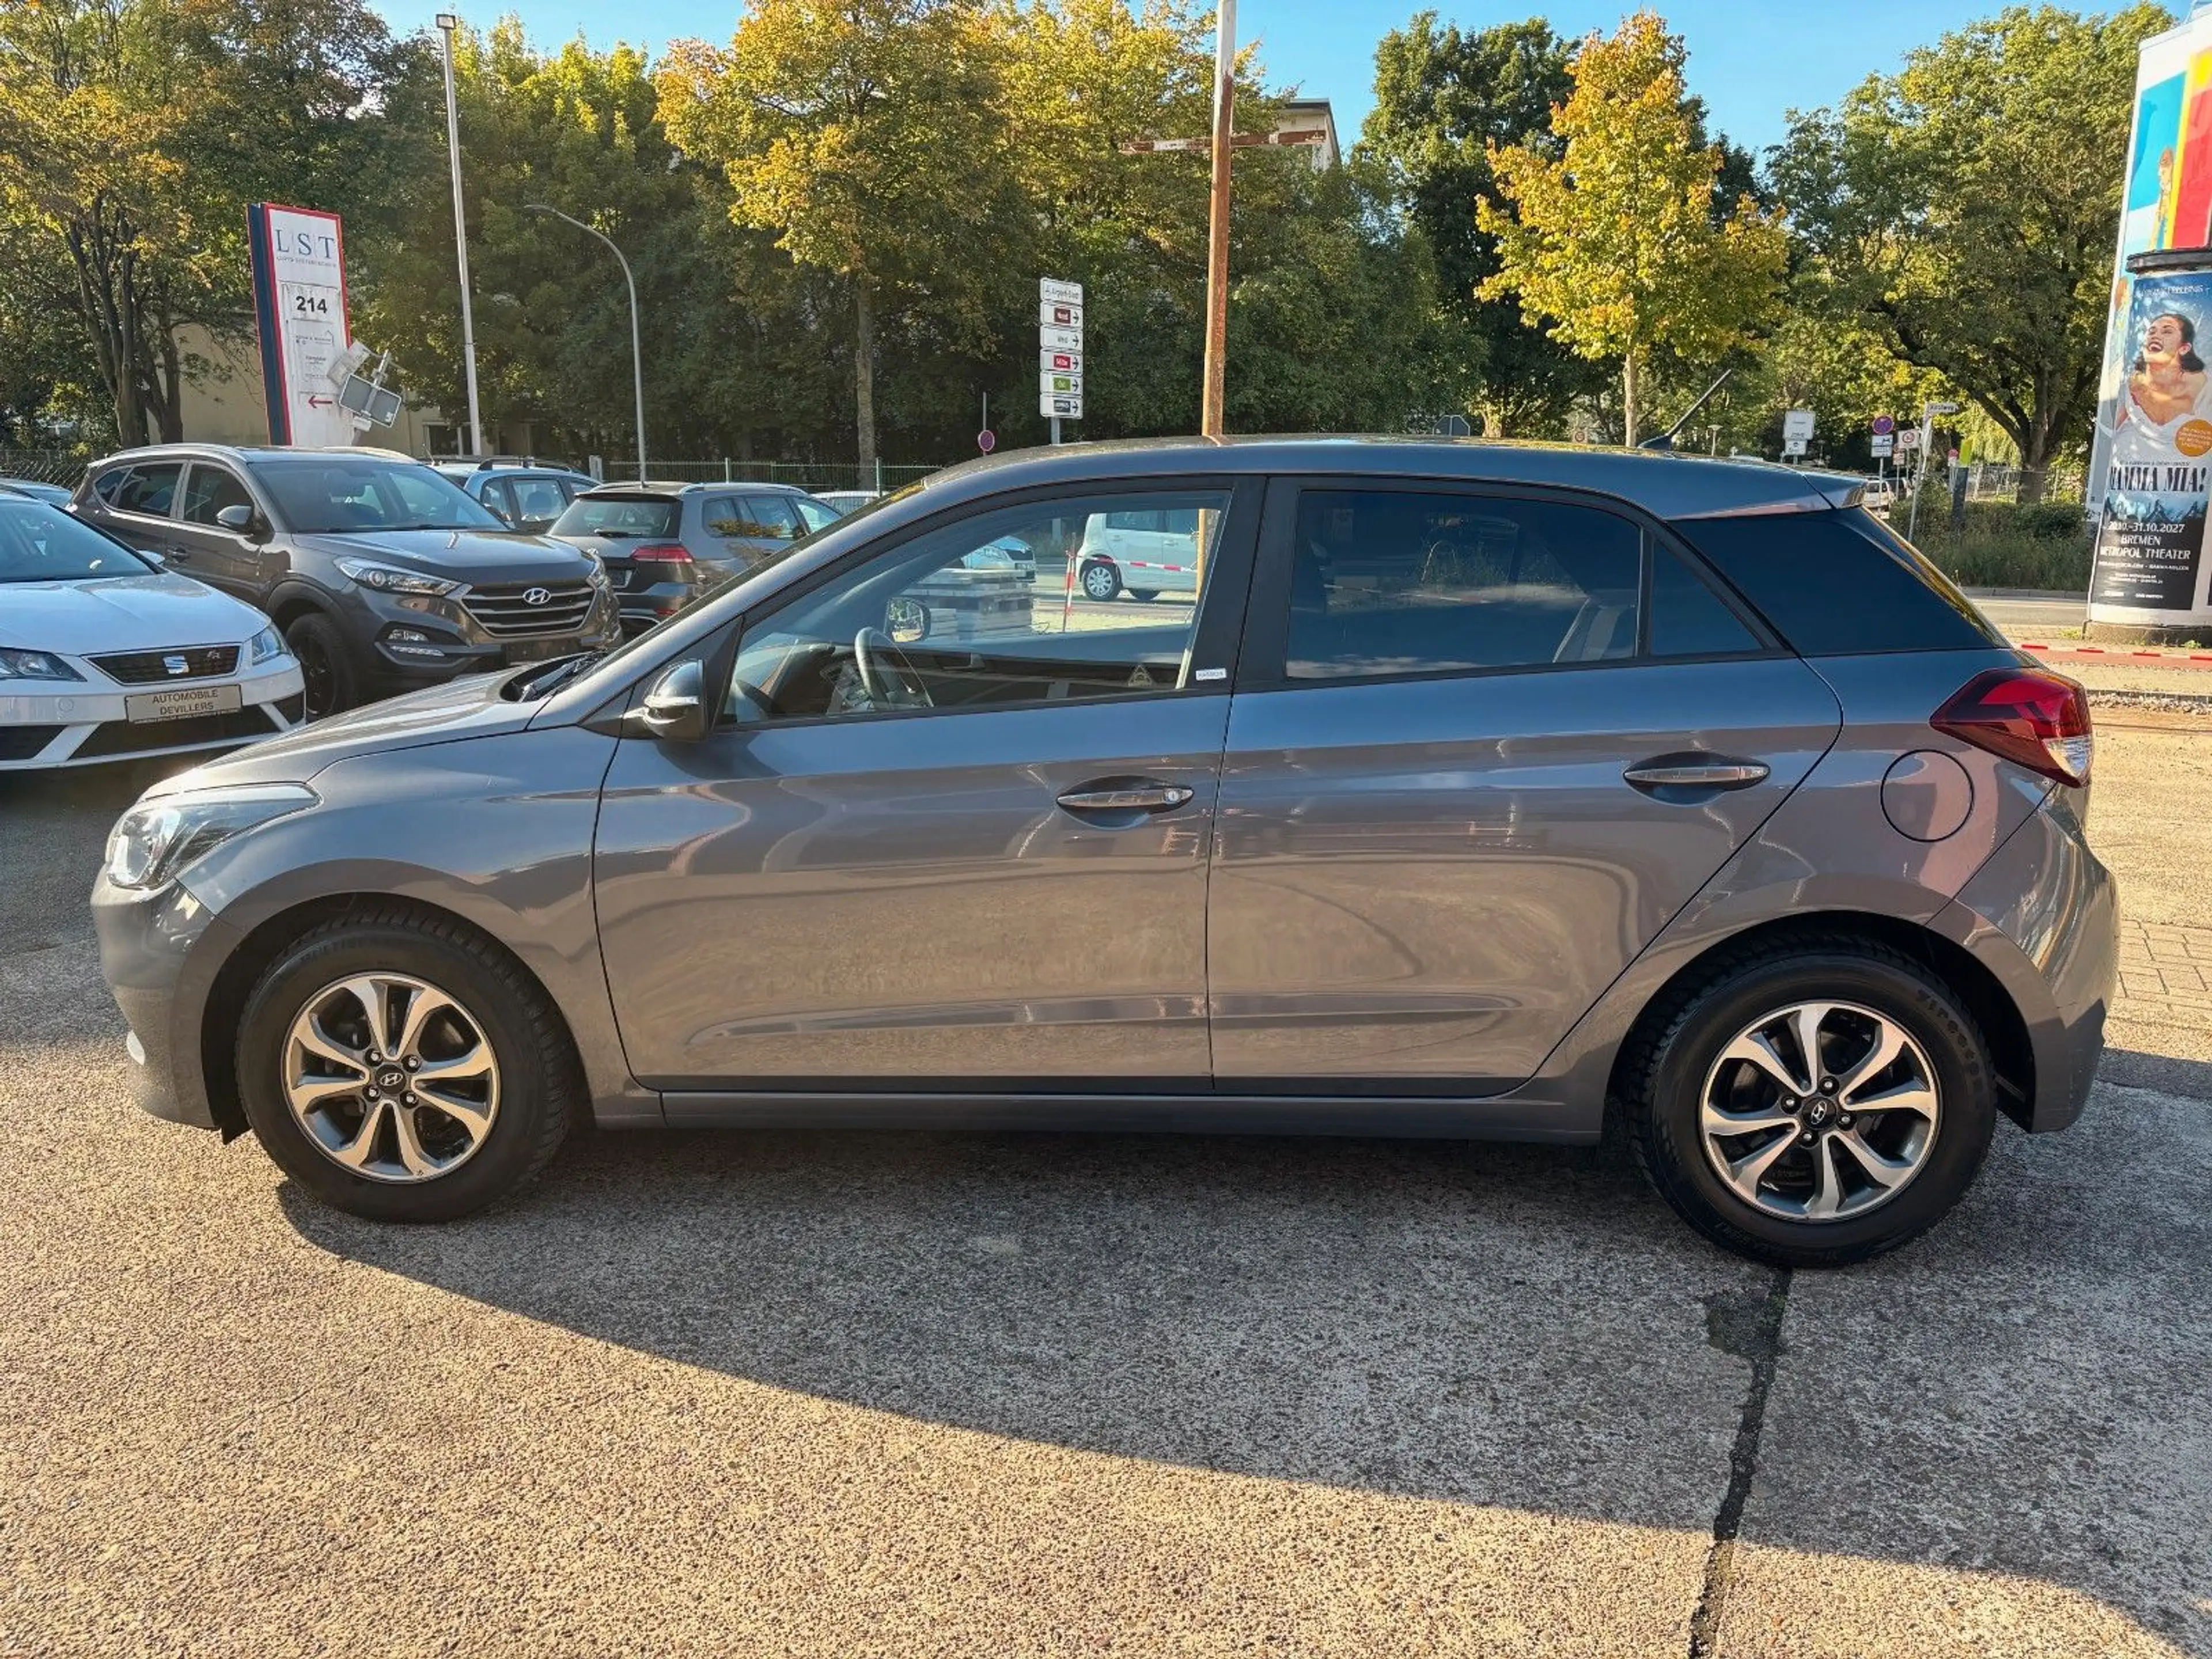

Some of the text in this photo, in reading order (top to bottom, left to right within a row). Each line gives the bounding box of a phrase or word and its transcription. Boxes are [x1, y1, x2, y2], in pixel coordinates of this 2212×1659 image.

[296, 296, 327, 313] 214
[2163, 467, 2207, 492] MIA!
[2120, 534, 2161, 546] BREMEN
[2145, 548, 2191, 560] THEATER
[152, 690, 218, 703] AUTOMOBILE
[160, 702, 214, 715] DEVILLERS
